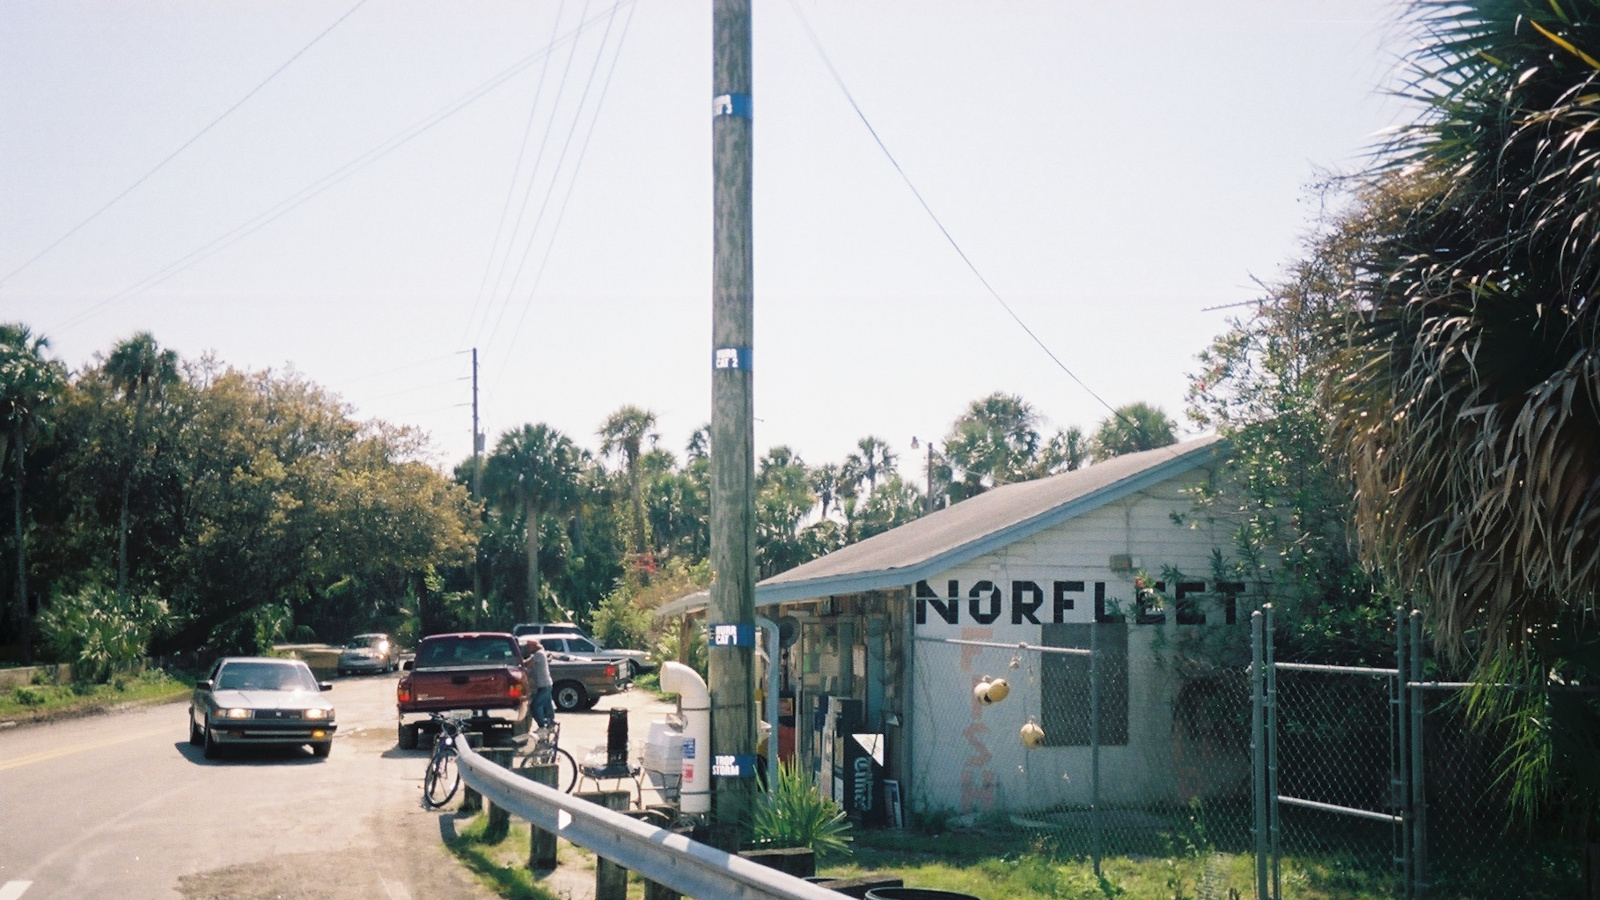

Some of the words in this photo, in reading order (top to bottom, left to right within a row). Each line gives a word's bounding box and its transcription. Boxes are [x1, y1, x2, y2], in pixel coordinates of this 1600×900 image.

[716, 358, 729, 368] CAT
[732, 358, 739, 368] 2
[915, 579, 1246, 625] NORFLEET
[715, 635, 729, 645] CAT
[715, 755, 736, 765] TROP
[713, 765, 739, 775] STORM
